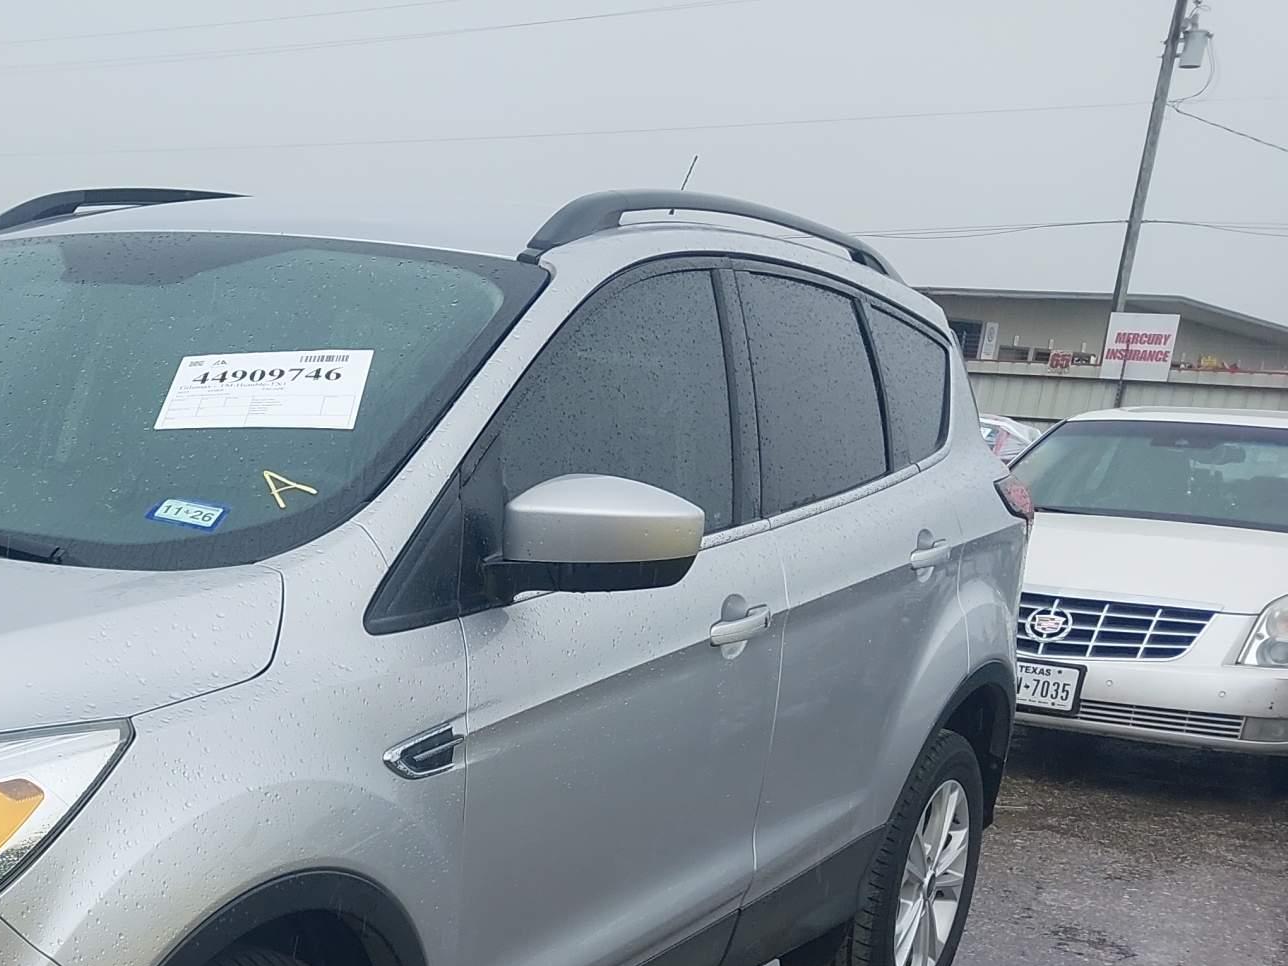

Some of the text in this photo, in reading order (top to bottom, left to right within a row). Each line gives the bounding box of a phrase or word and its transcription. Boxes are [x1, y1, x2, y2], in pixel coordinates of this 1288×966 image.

[1114, 331, 1172, 346] MERCURY
[1104, 348, 1171, 363] INSURANCE
[191, 366, 344, 385] 44909746
[263, 470, 319, 509] A
[1019, 664, 1052, 677] TEXAS
